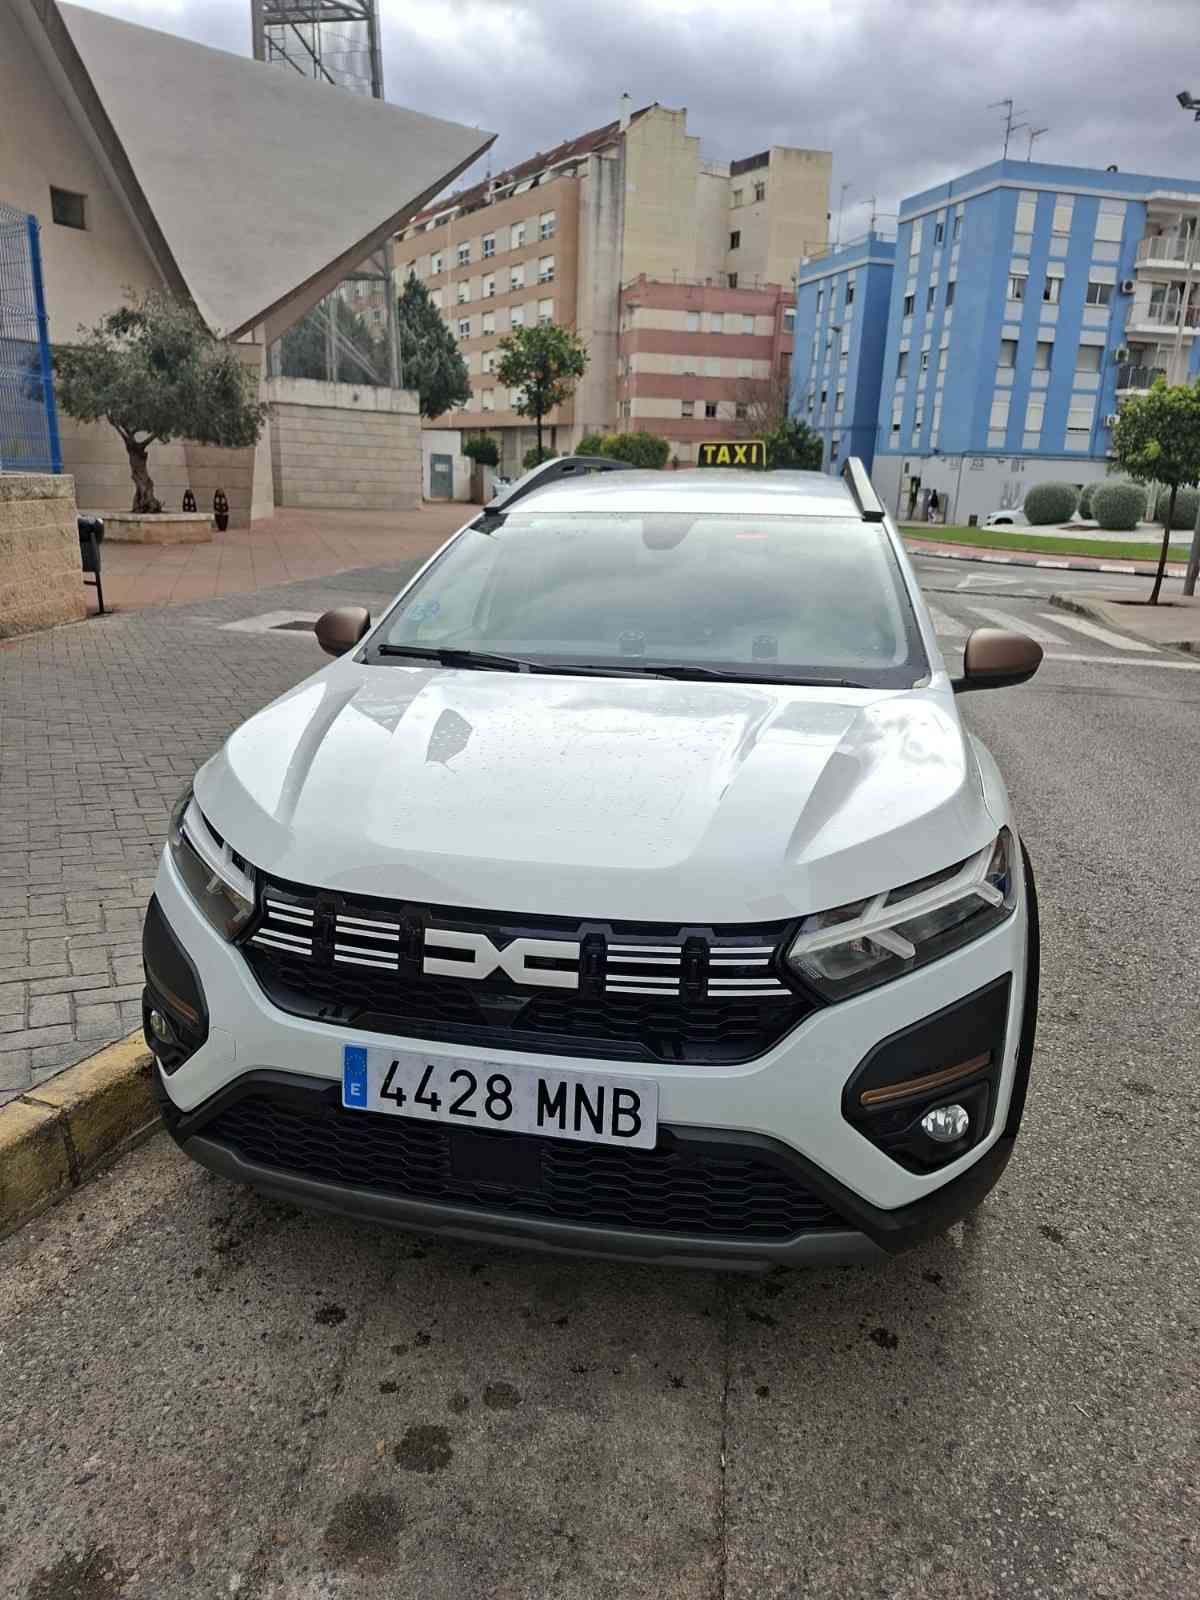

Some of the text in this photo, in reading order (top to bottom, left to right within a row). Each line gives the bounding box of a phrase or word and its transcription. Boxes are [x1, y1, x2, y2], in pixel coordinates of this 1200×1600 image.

[704, 445, 757, 464] TAXI
[350, 1083, 361, 1096] E
[380, 1060, 642, 1138] 4428 MNB
